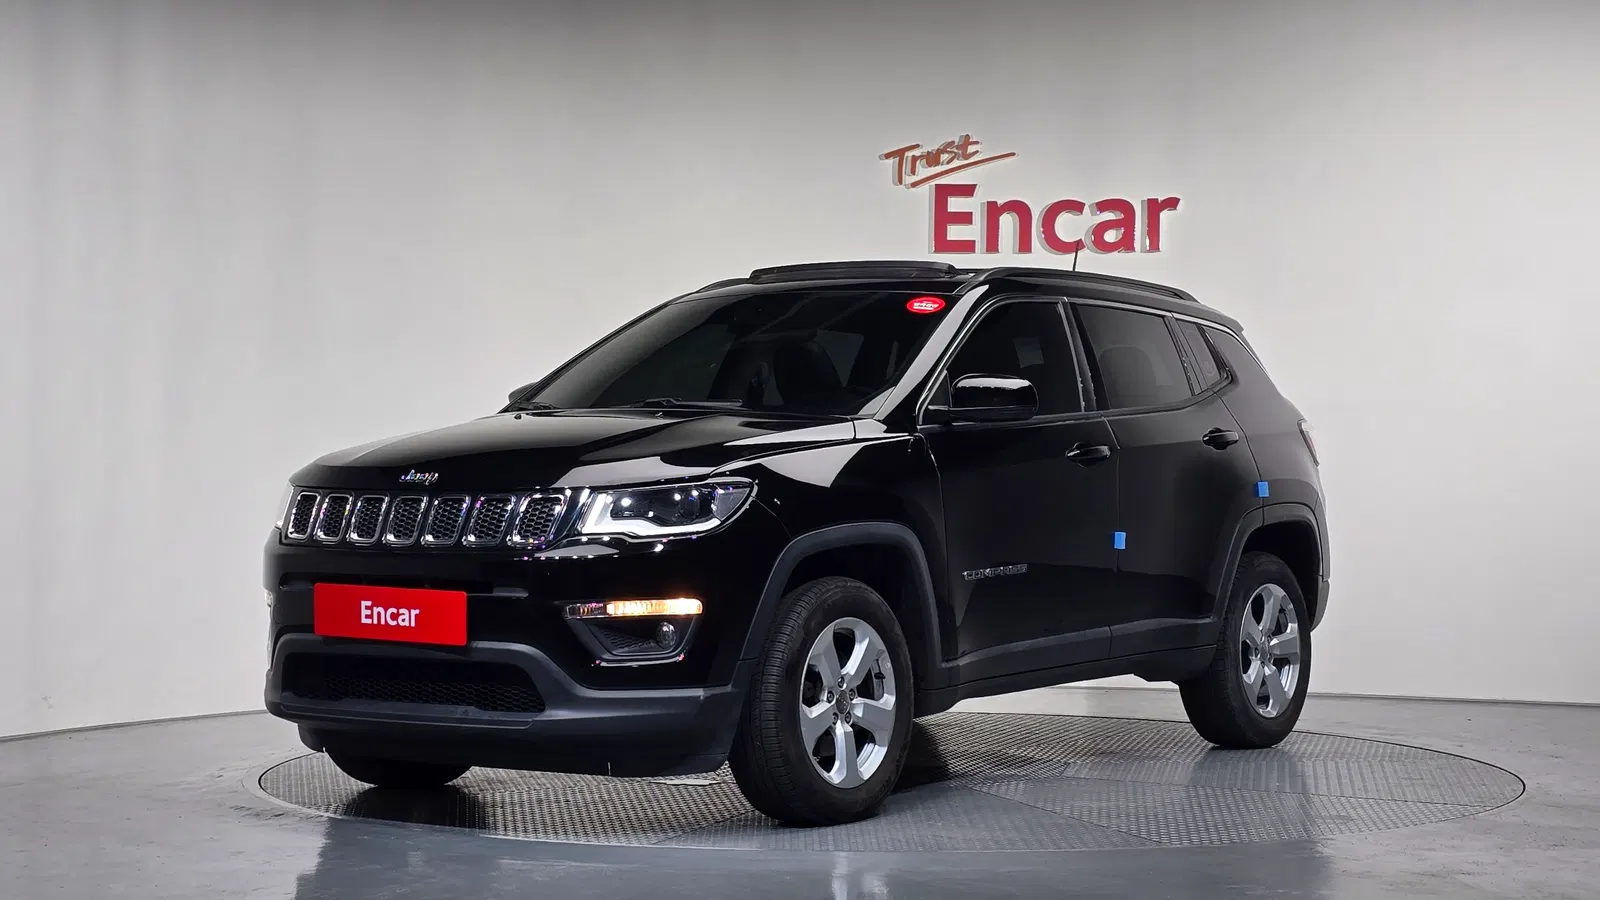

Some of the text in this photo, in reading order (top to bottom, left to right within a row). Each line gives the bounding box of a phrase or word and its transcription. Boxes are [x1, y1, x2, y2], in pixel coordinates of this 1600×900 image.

[880, 134, 980, 185] Trust
[930, 183, 1181, 254] Encar
[399, 469, 439, 486] Jeep
[360, 600, 420, 627] Encar
